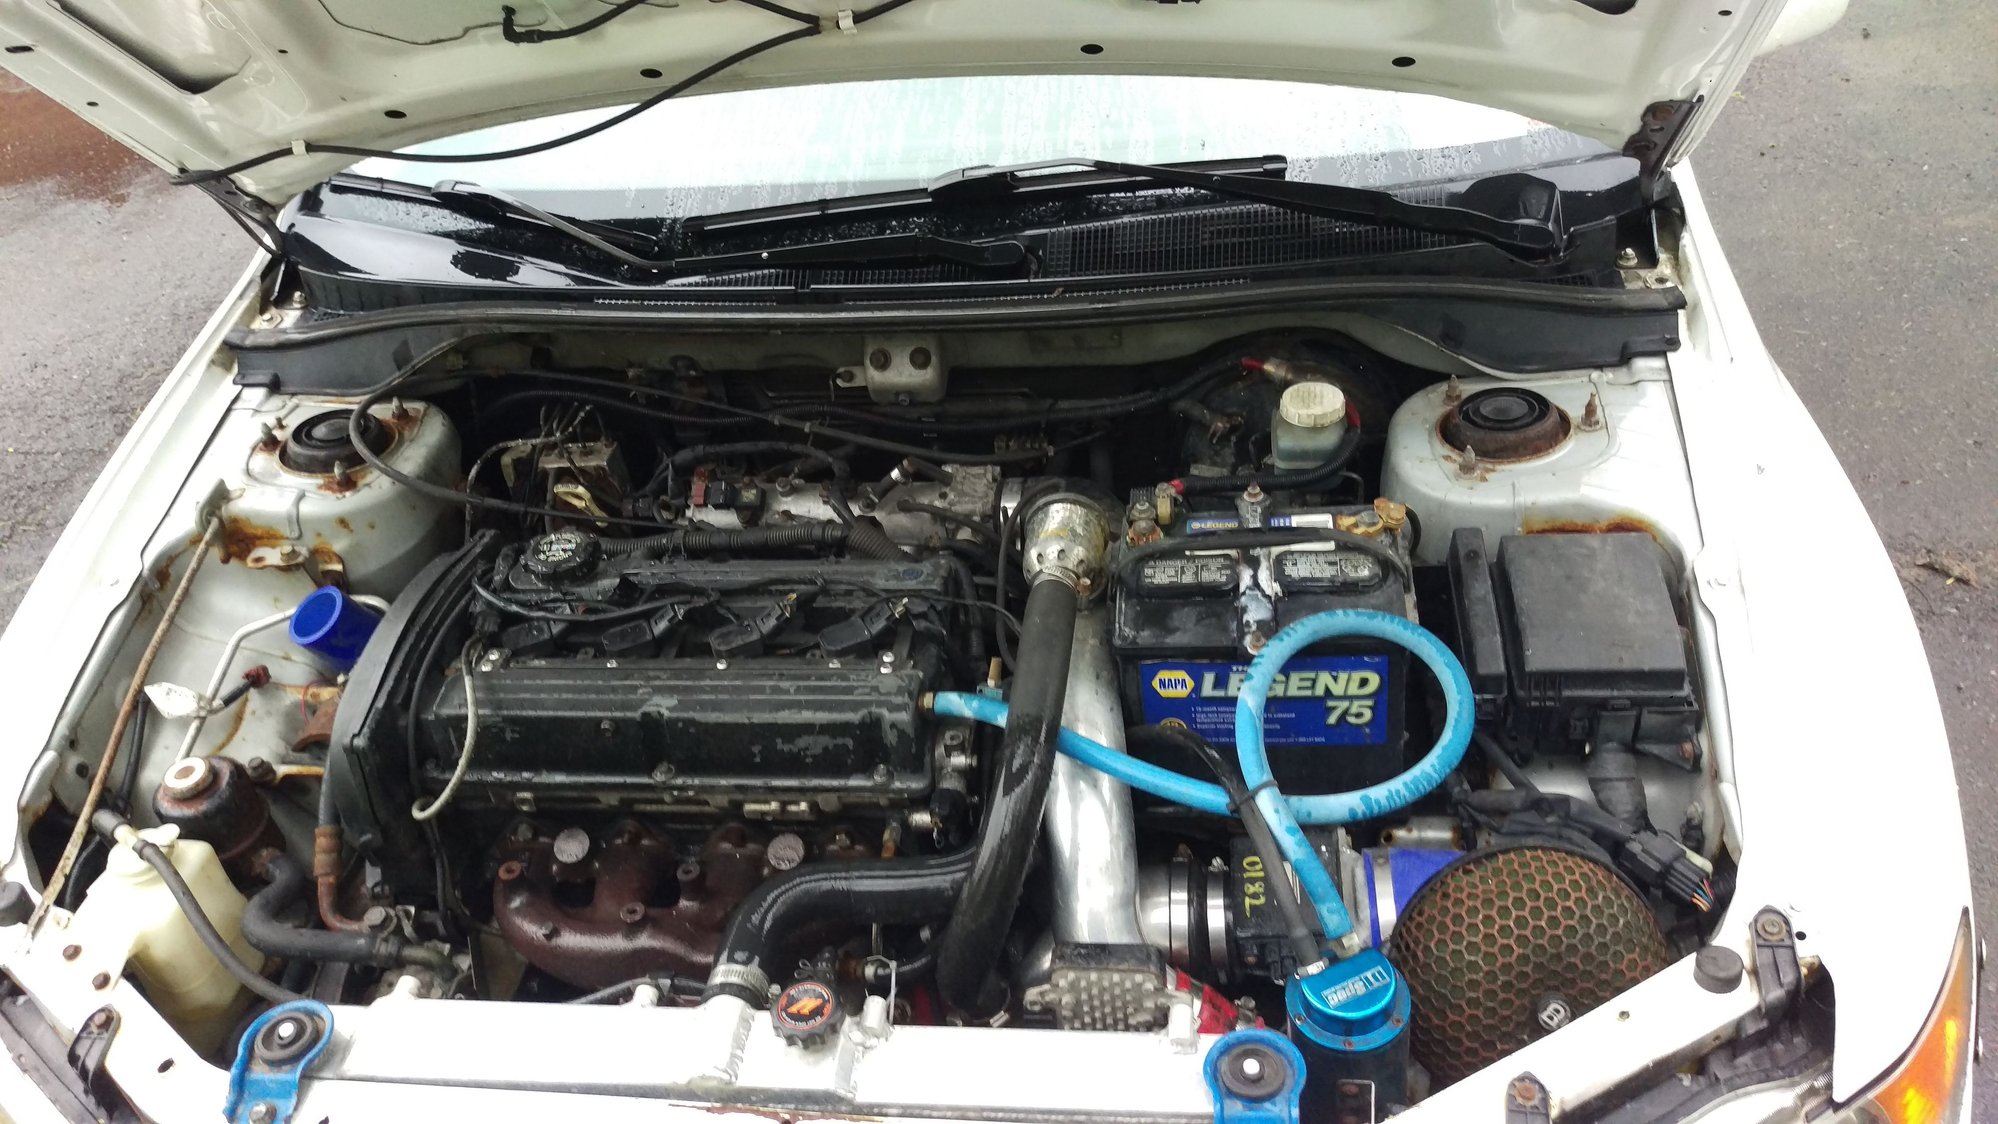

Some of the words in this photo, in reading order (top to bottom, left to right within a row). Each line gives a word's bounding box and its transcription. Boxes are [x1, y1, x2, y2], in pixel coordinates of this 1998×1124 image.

[1201, 521, 1238, 529] LEGEND
[1158, 678, 1188, 691] NAPA
[1325, 698, 1375, 726] 75
